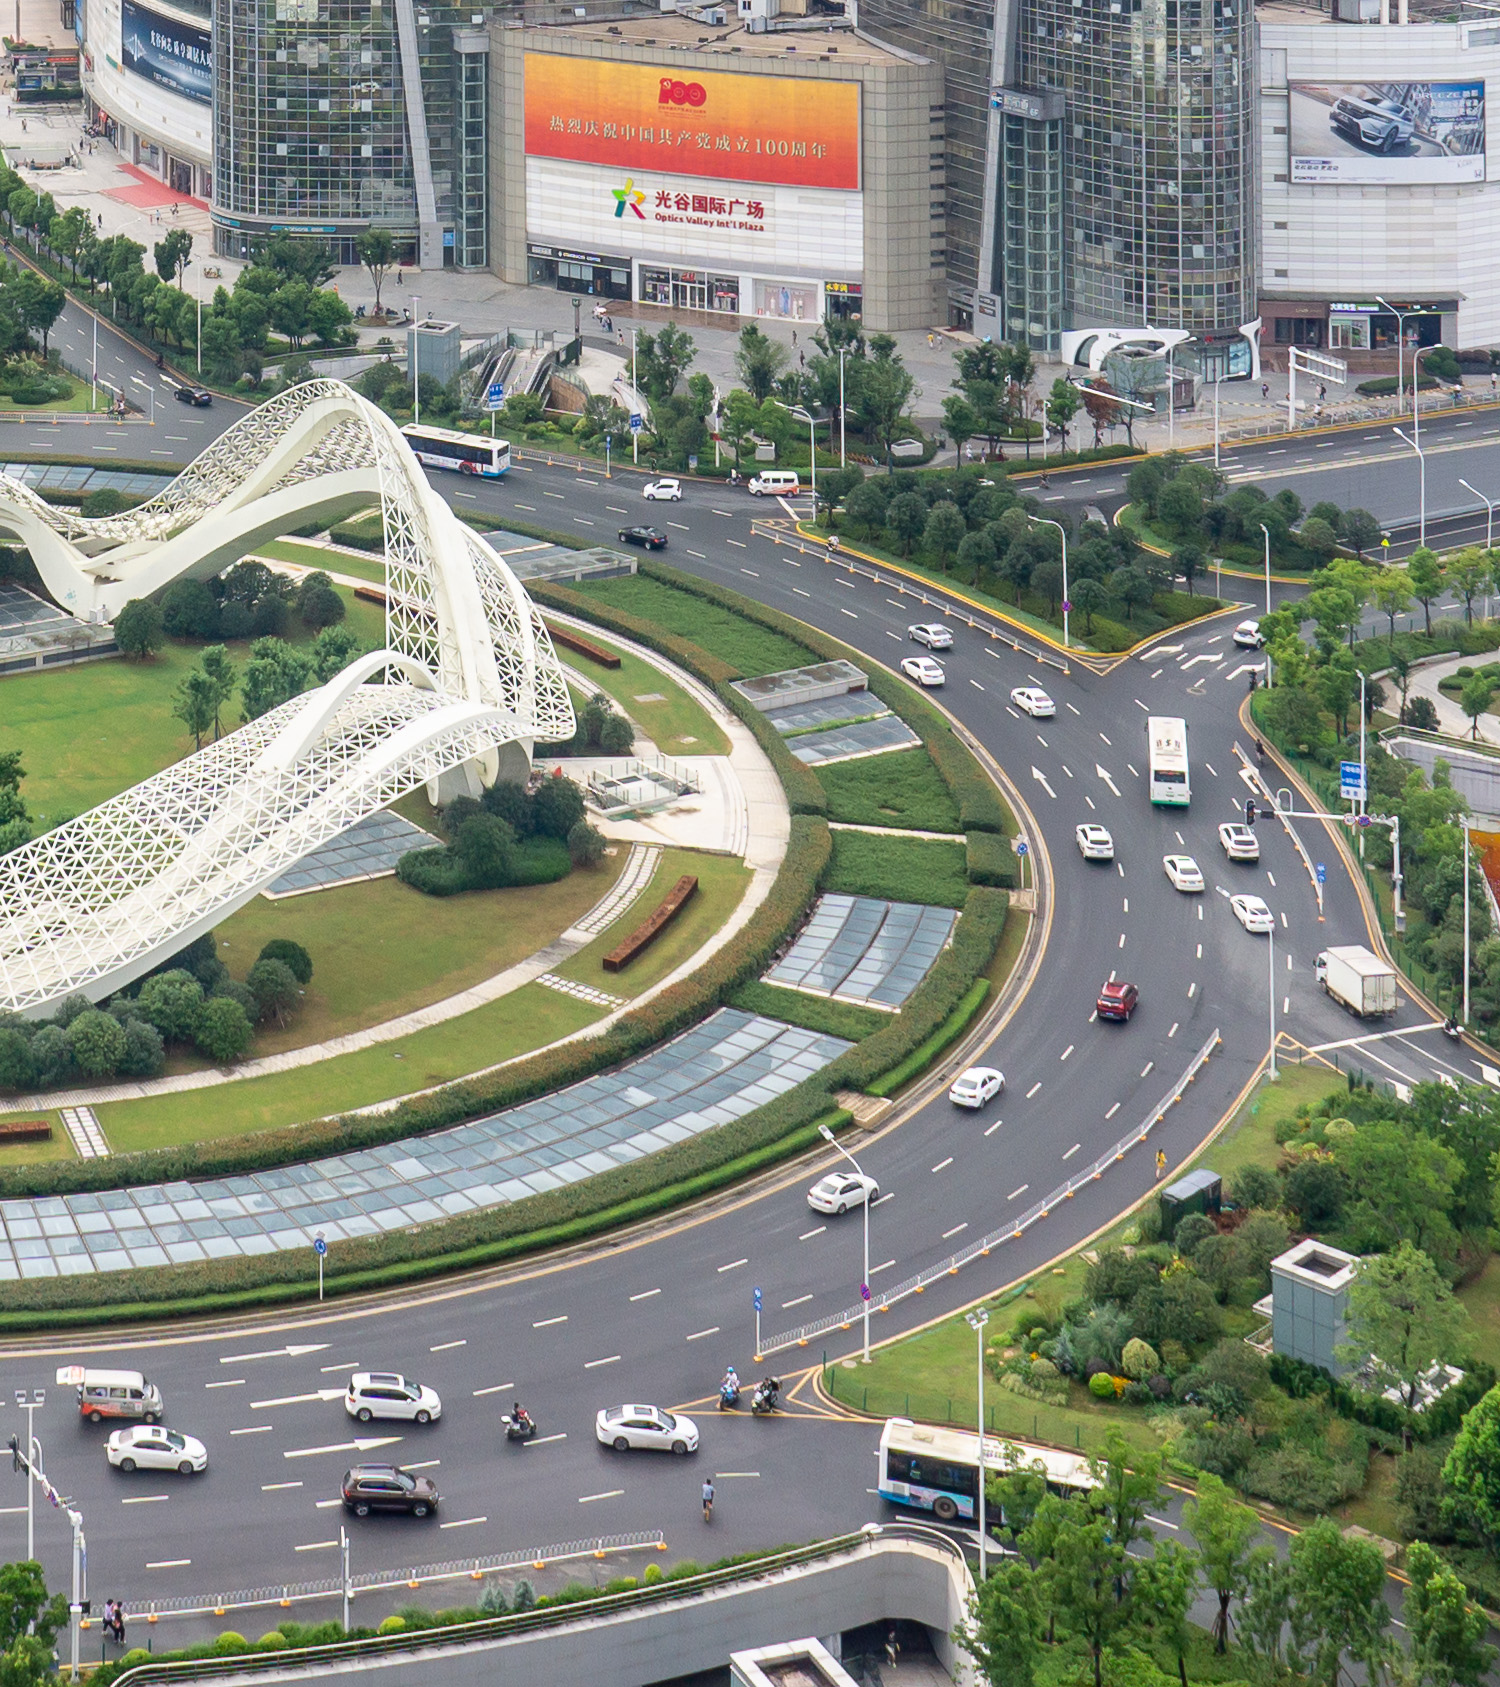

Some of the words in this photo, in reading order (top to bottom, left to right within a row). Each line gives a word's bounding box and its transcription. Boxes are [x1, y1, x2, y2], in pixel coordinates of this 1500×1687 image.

[550, 115, 827, 159] 热烈庆祝中国共产党成立100周年
[655, 190, 765, 220] 光谷国际广场
[655, 213, 684, 224] Optics
[686, 216, 714, 228] Valley
[716, 219, 737, 229] Int'l
[738, 222, 764, 232] Plaza
